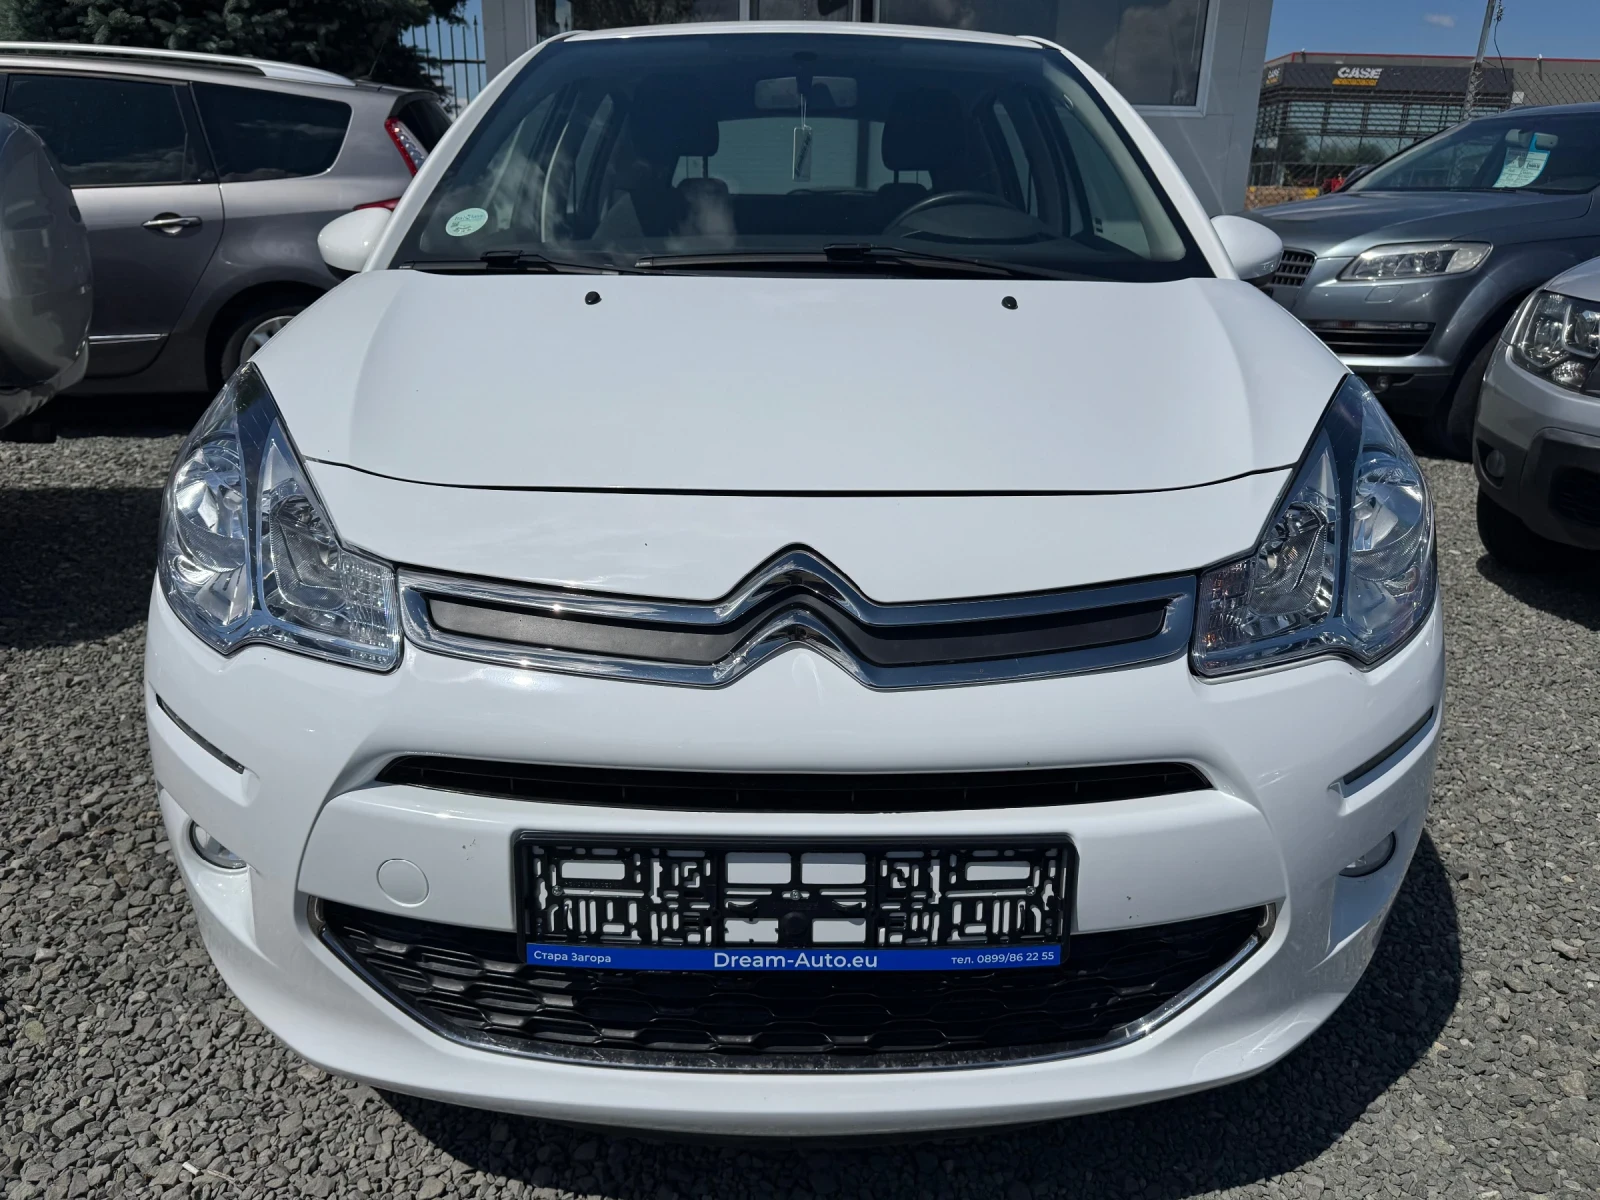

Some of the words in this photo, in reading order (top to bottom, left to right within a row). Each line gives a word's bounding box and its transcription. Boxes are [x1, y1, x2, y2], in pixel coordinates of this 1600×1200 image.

[1337, 67, 1383, 79] CASE
[533, 950, 568, 962] Стара
[571, 952, 612, 965] Загора
[713, 952, 878, 968] Dream-Auto.eu
[951, 956, 974, 965] тел.
[977, 952, 1024, 964] 0899/86
[1026, 952, 1039, 961] 22
[1041, 951, 1055, 961] 55
